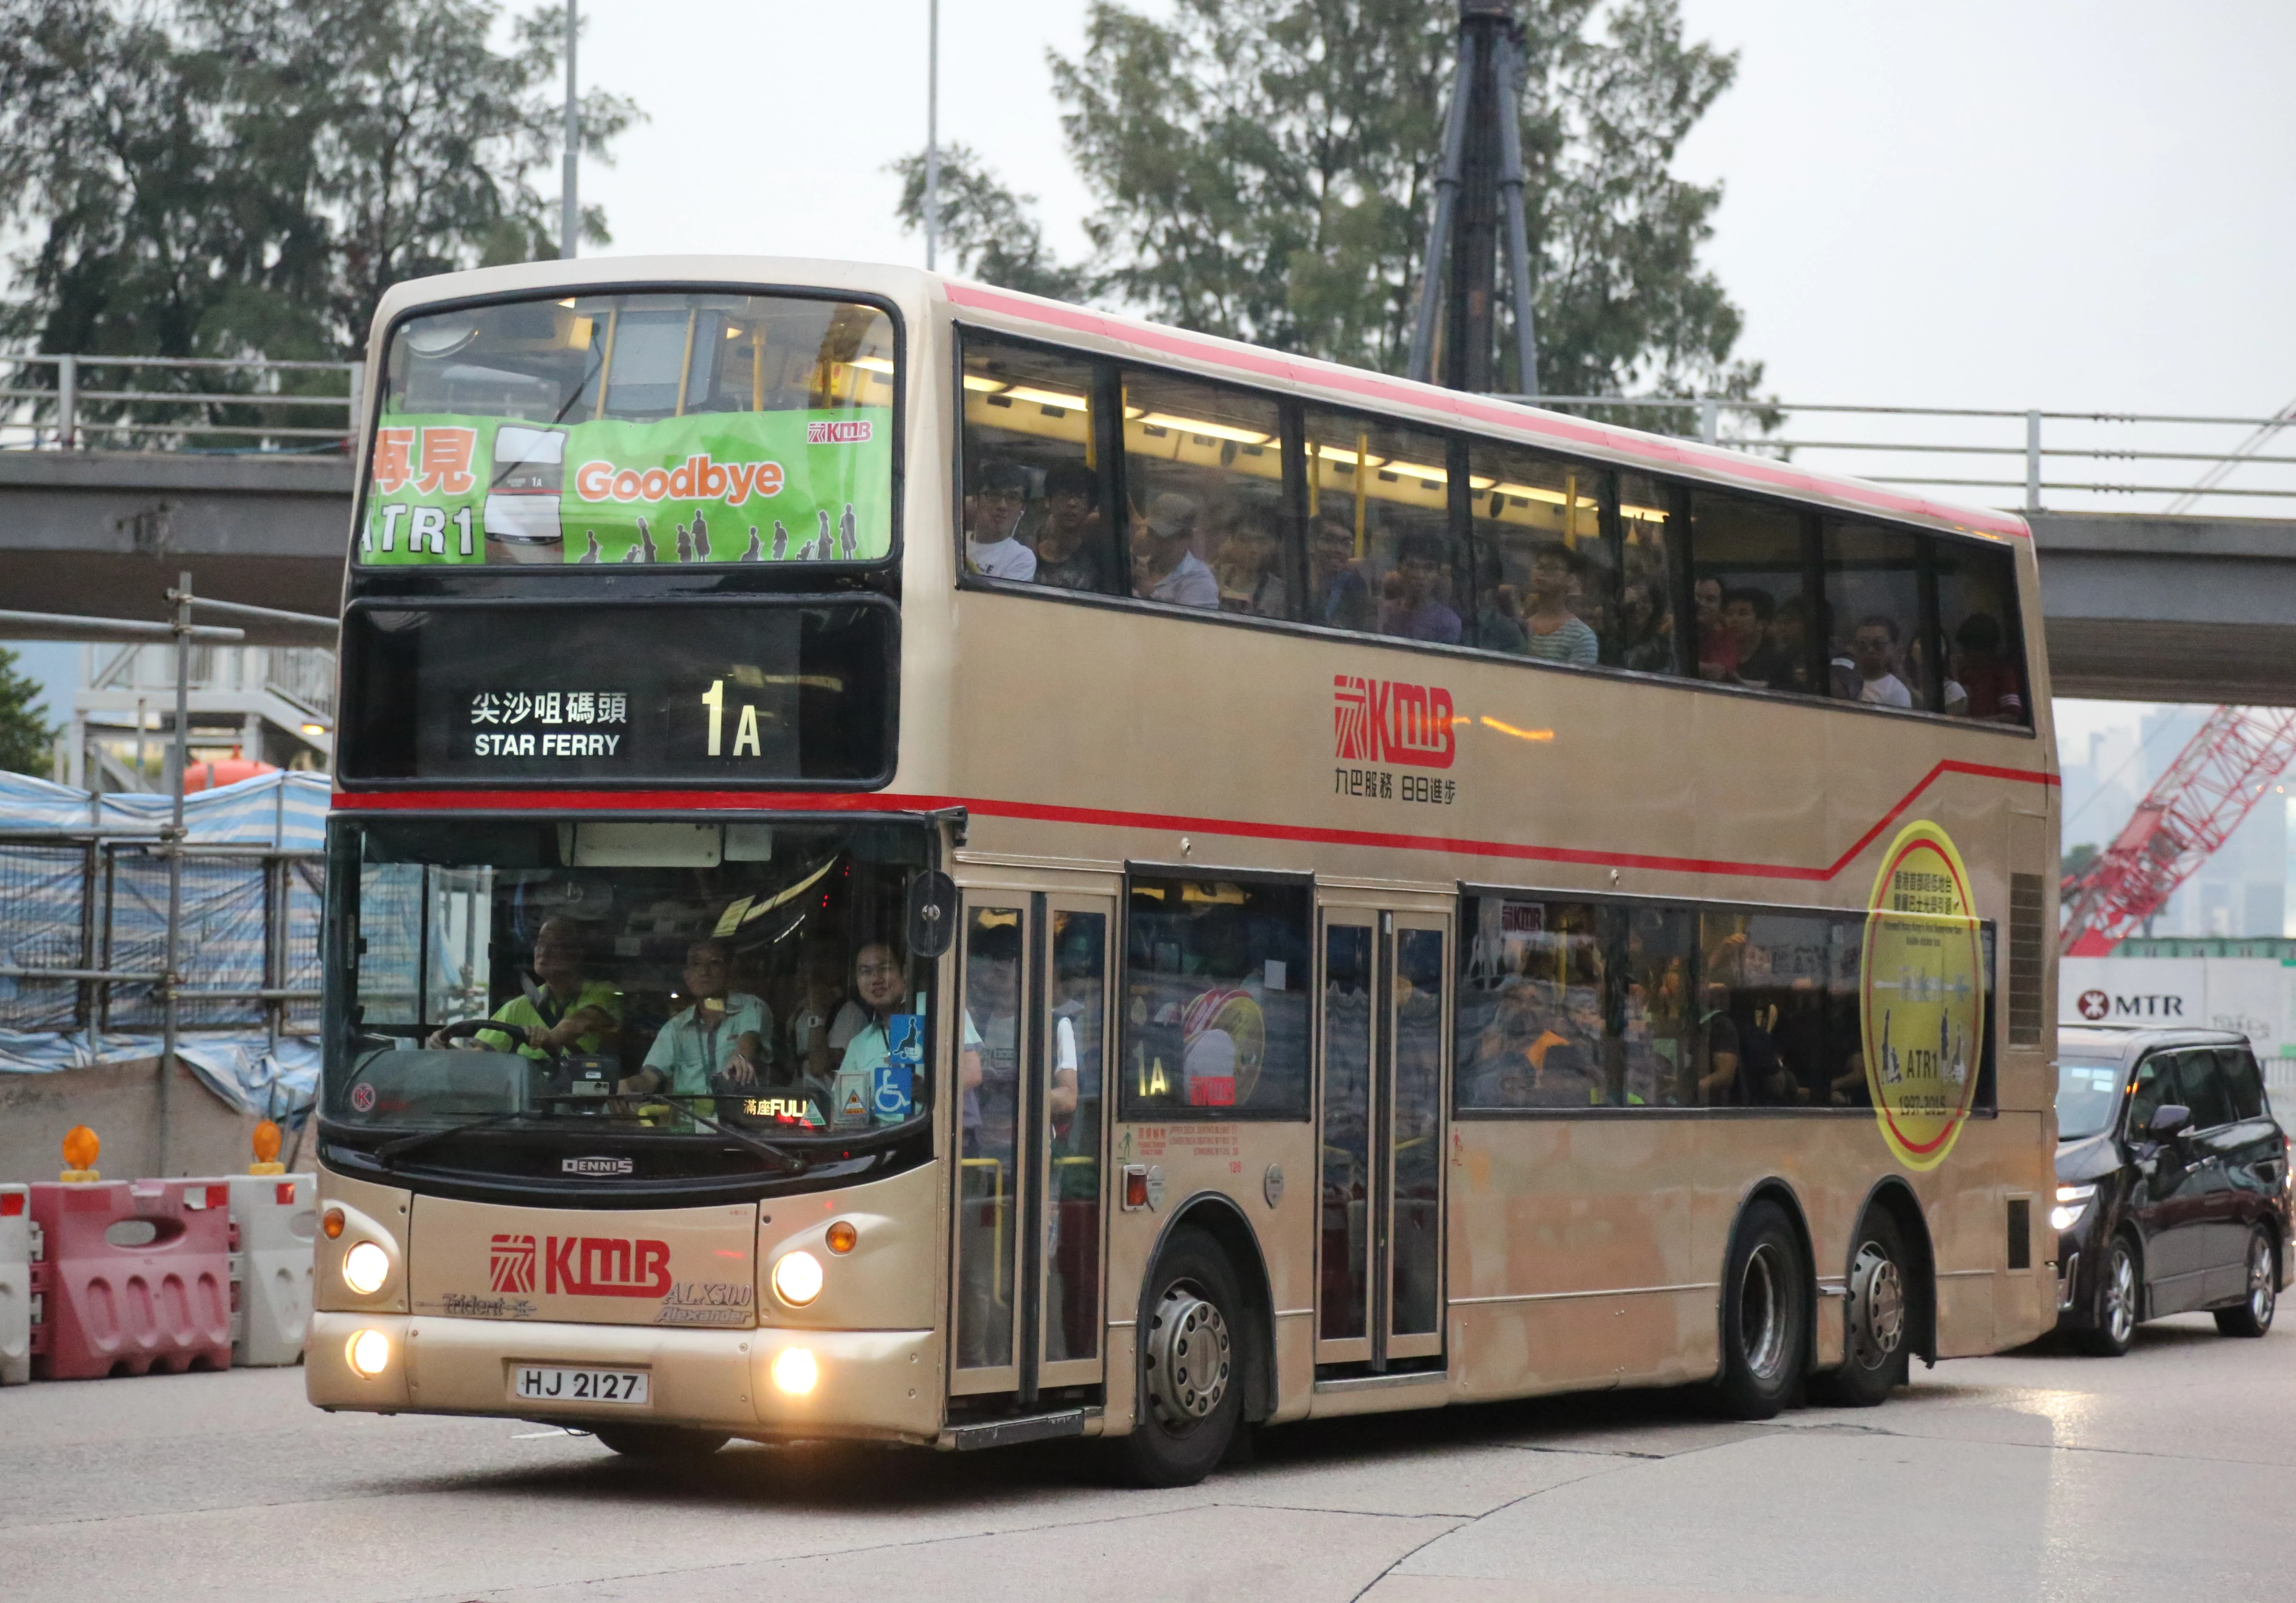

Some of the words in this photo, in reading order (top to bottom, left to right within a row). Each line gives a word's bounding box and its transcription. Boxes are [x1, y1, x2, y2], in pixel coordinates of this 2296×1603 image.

[828, 422, 871, 441] KMB
[532, 477, 542, 487] 1A
[576, 454, 784, 506] Goodbye
[471, 692, 626, 724] 尖沙咀碼頭
[702, 680, 761, 756] 1A
[1369, 679, 1455, 769] KMB
[475, 734, 535, 756] STAR
[543, 734, 620, 756] FERRY
[1335, 767, 1393, 799] 九巴服務
[1402, 776, 1456, 805] 日日進步
[2115, 995, 2183, 1016] MTR
[1132, 1040, 1166, 1097] 1A
[1906, 1049, 1937, 1079] ATR1
[743, 1099, 770, 1116] 滿座
[562, 1158, 633, 1173] DENNIS
[1229, 1161, 1241, 1173] 126
[546, 1236, 672, 1298] KMB
[442, 1293, 505, 1316] Trident
[663, 1283, 752, 1306] ALX500
[654, 1307, 753, 1324] Alexander
[525, 1370, 562, 1396] HJ
[573, 1373, 639, 1399] 2127
